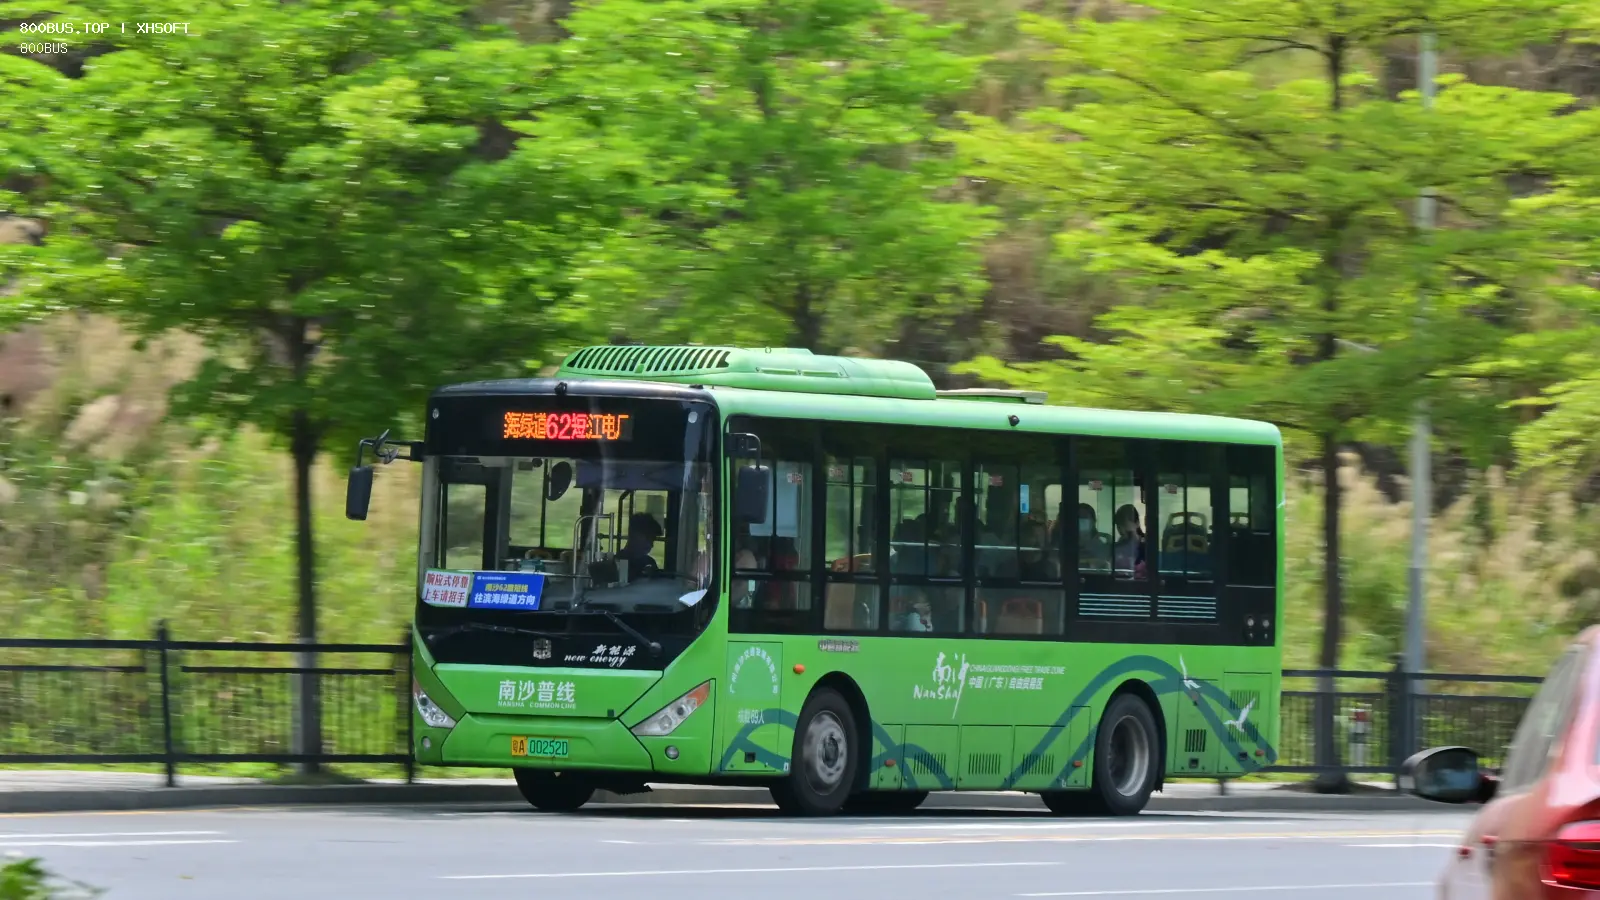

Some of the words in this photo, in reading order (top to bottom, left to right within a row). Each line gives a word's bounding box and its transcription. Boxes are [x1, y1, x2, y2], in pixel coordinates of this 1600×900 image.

[423, 588, 466, 603] 上车请招手
[474, 593, 536, 606] 往滨海绿道方向
[592, 644, 637, 656] 新能源
[589, 655, 628, 667] energy
[498, 679, 576, 702] 南沙普线
[529, 701, 560, 709] COMMON
